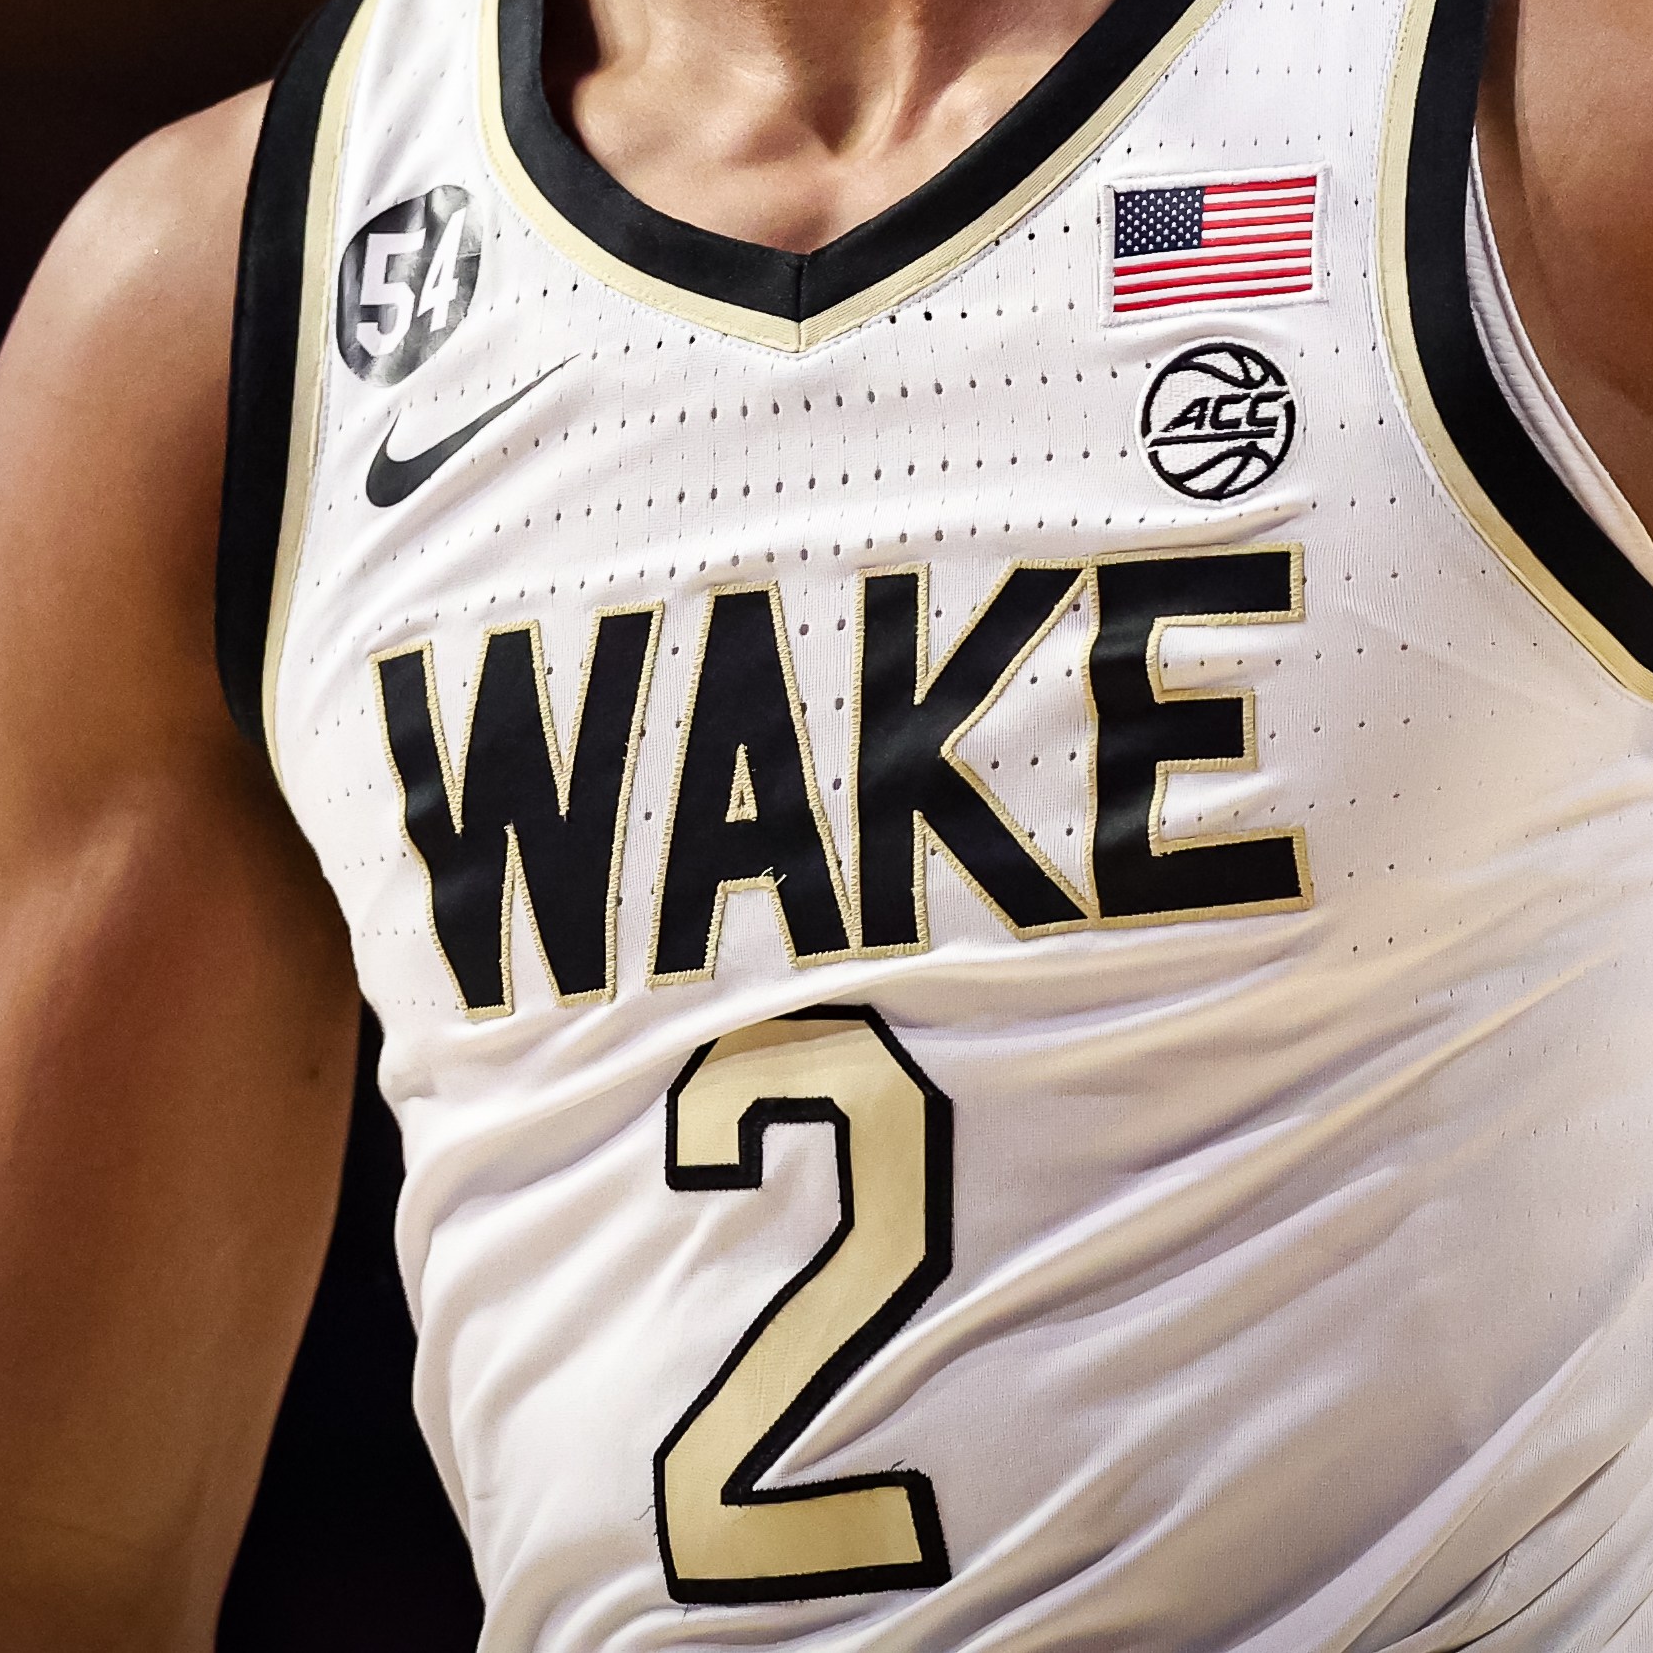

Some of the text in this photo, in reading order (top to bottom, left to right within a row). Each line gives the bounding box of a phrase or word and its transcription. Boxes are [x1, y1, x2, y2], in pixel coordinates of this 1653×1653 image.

[356, 206, 467, 356] 54
[1159, 390, 1291, 433] ACC
[370, 542, 1314, 1019] WAKE
[653, 1003, 954, 1605] 2
